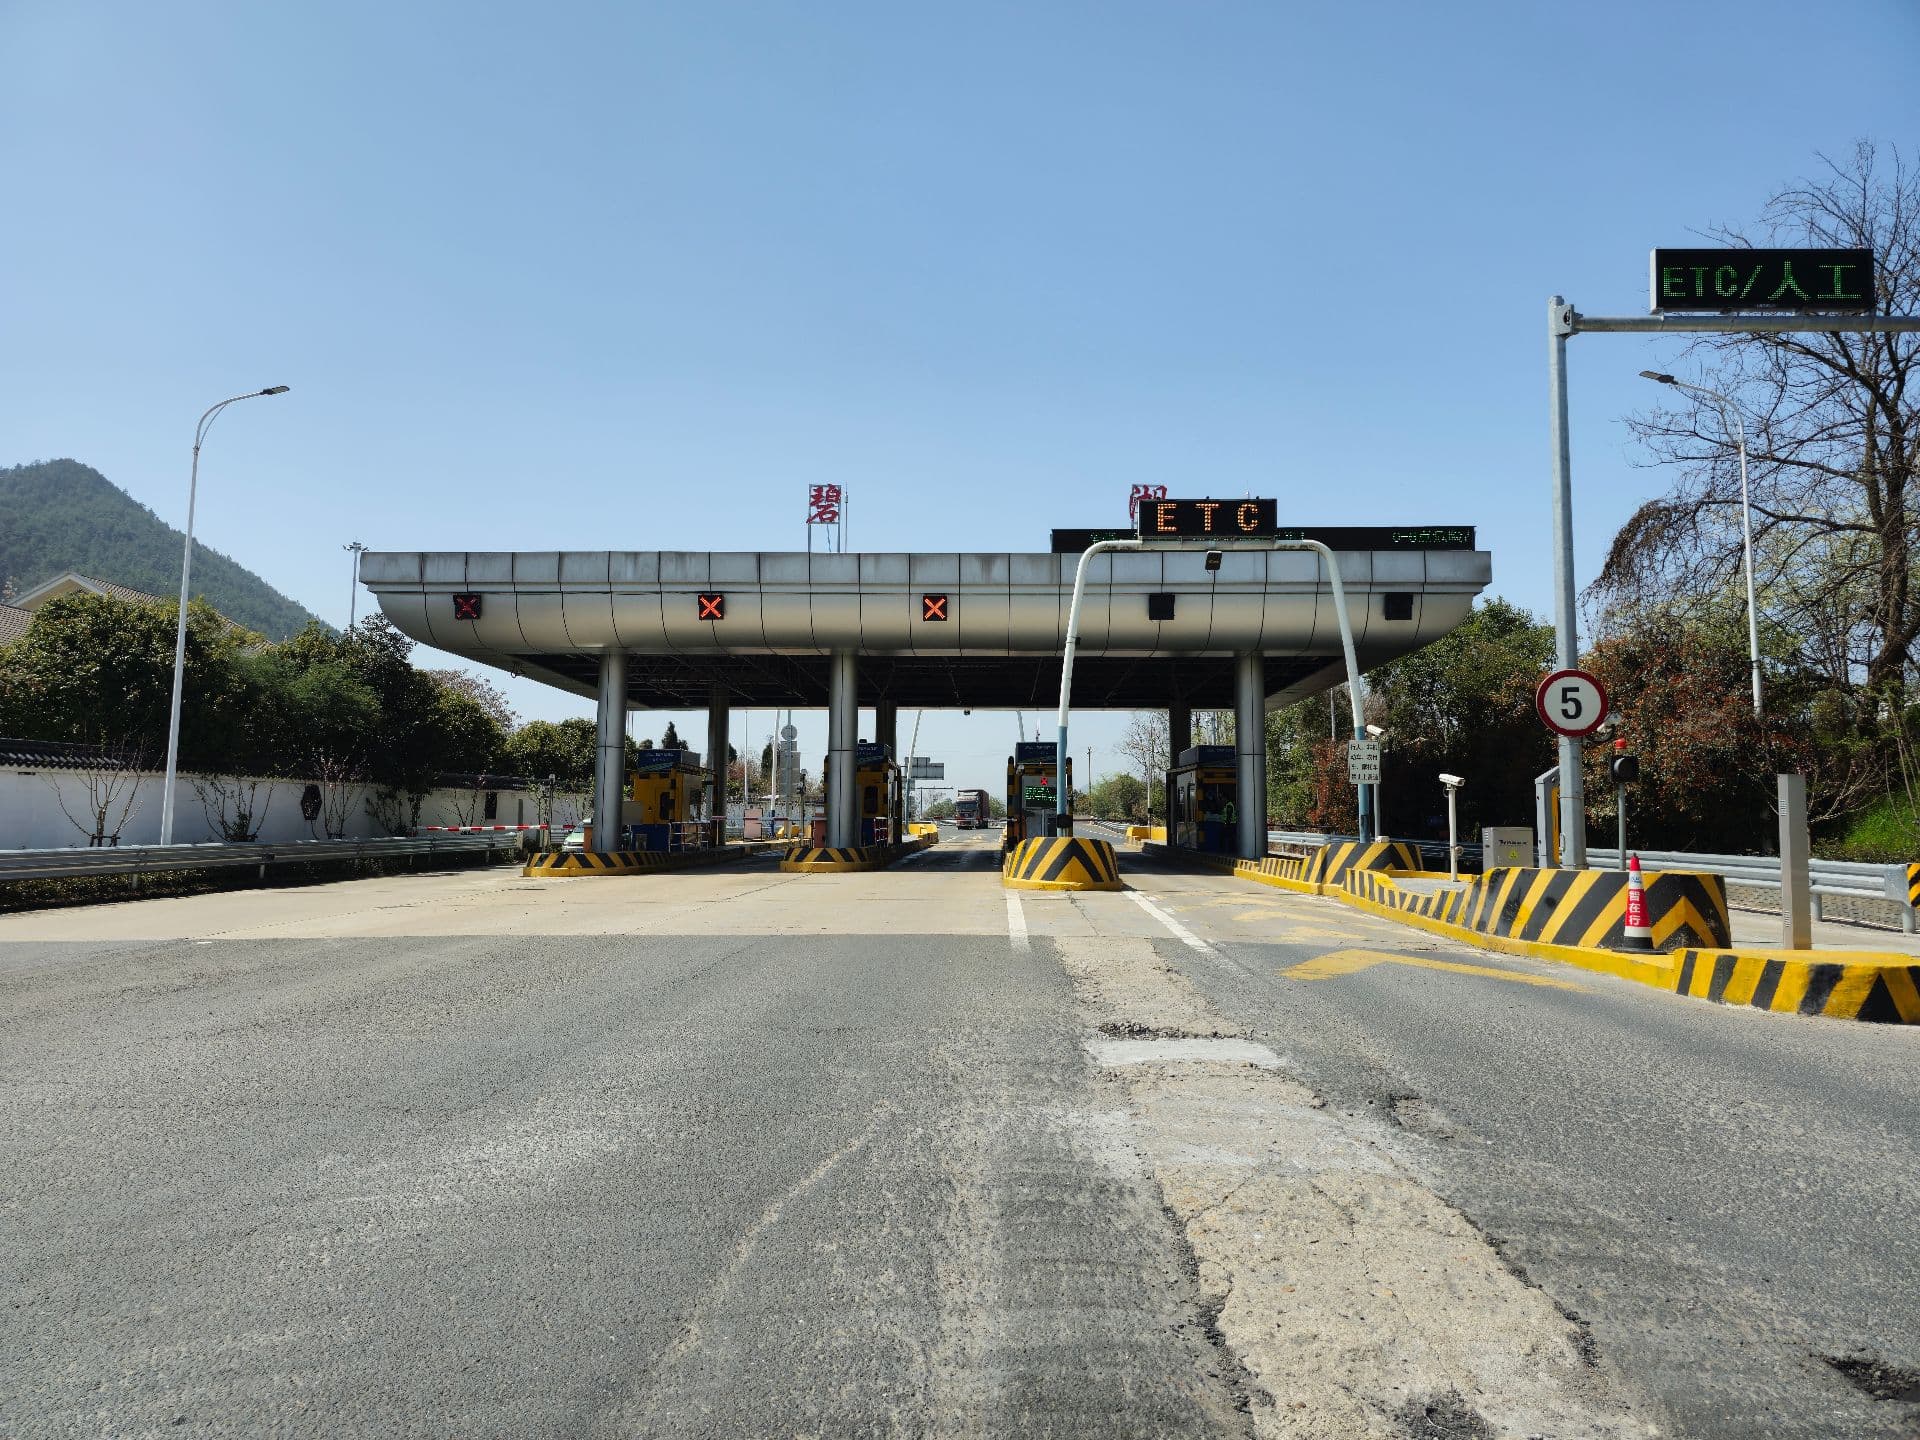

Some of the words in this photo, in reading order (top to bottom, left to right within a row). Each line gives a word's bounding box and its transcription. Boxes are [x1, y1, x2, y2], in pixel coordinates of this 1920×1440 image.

[1663, 259, 1862, 301] ETC/人工
[806, 484, 841, 524] 碧
[1157, 503, 1258, 532] ETC
[1561, 686, 1582, 719] 5
